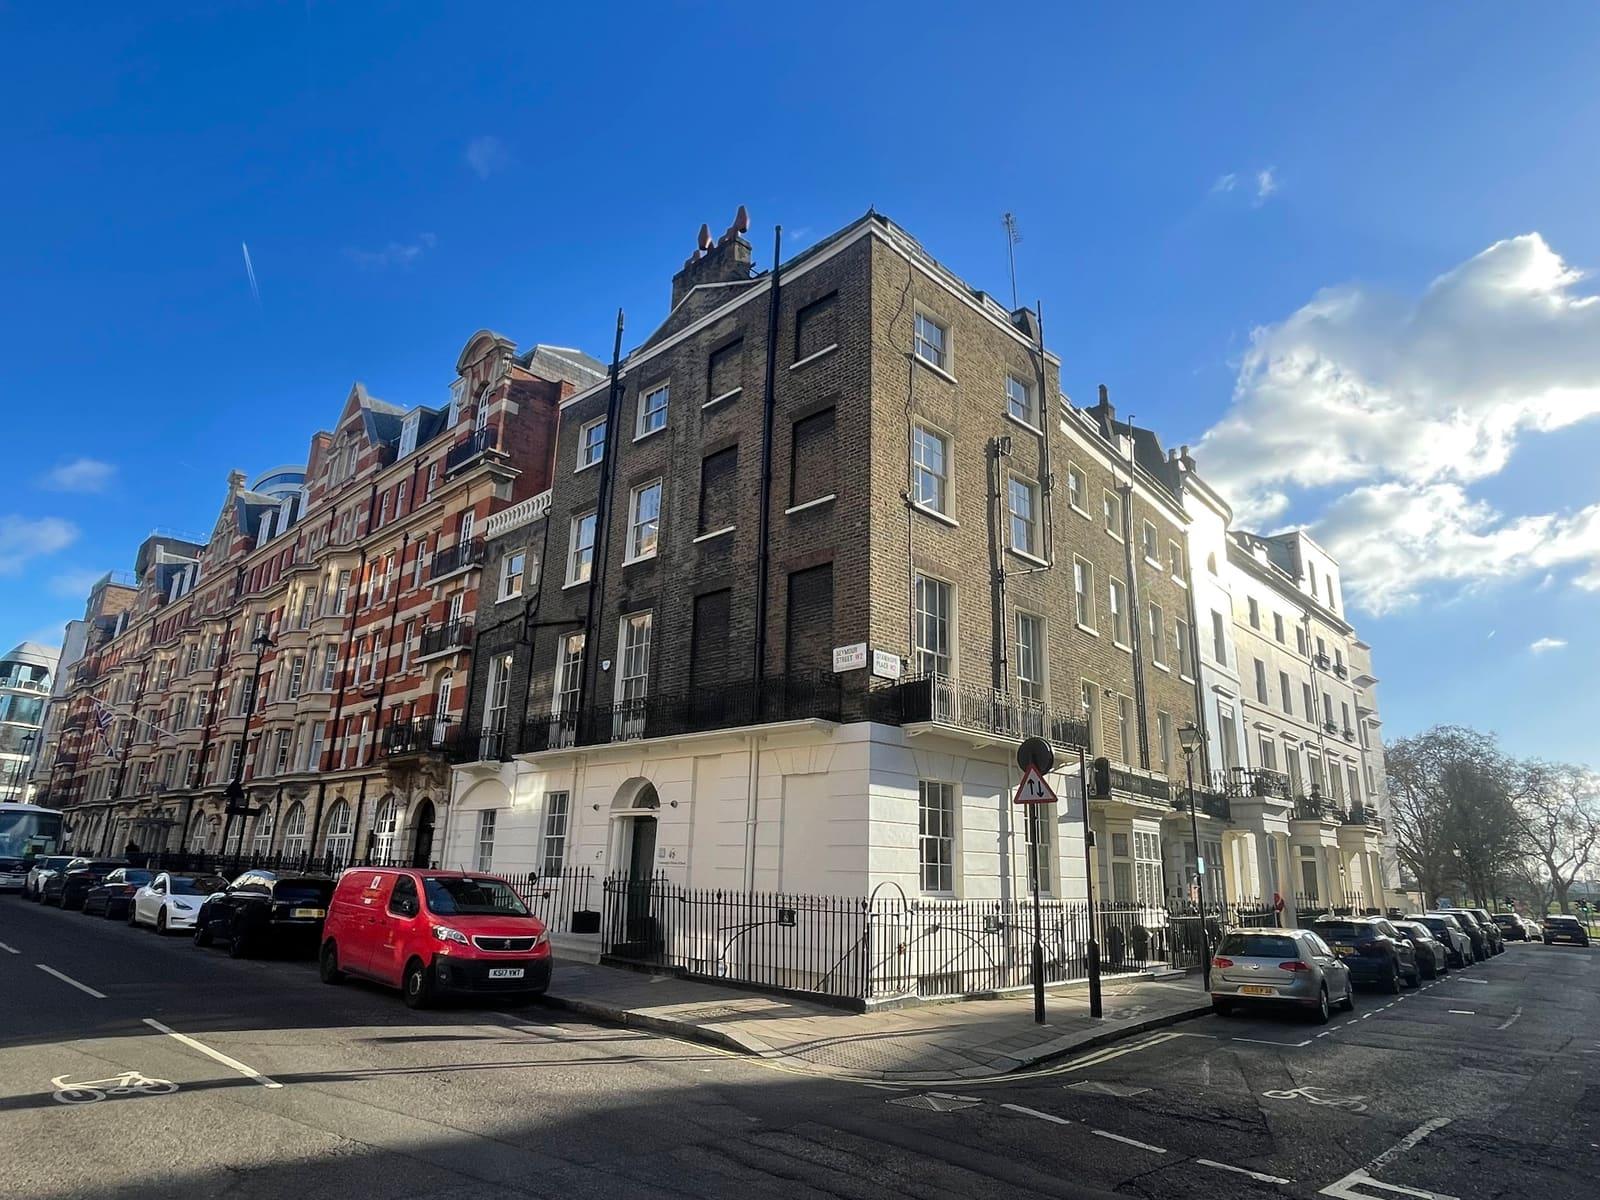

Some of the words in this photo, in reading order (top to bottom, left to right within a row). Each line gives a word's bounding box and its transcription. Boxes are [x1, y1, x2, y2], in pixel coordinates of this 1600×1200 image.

[836, 647, 858, 656] SEYMOUR
[836, 655, 853, 664] STREET
[854, 653, 863, 661] W2
[876, 661, 889, 670] PLACE
